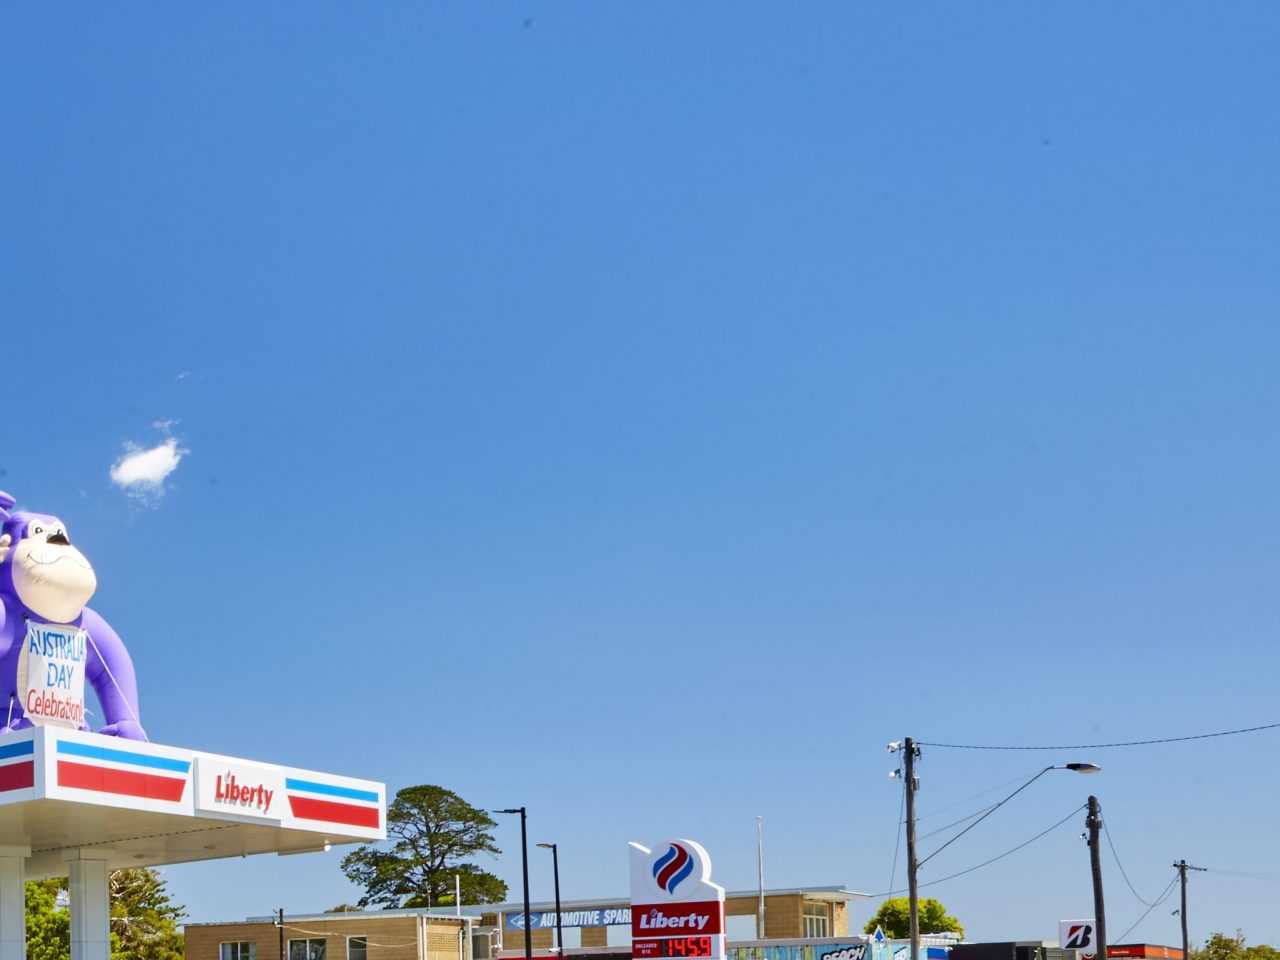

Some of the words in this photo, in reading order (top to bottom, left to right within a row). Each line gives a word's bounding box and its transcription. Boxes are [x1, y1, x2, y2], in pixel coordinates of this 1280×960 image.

[29, 627, 83, 662] AUSTRALIA
[47, 662, 74, 690] DAY
[216, 771, 273, 815] Liberty
[640, 909, 709, 930] Liberty
